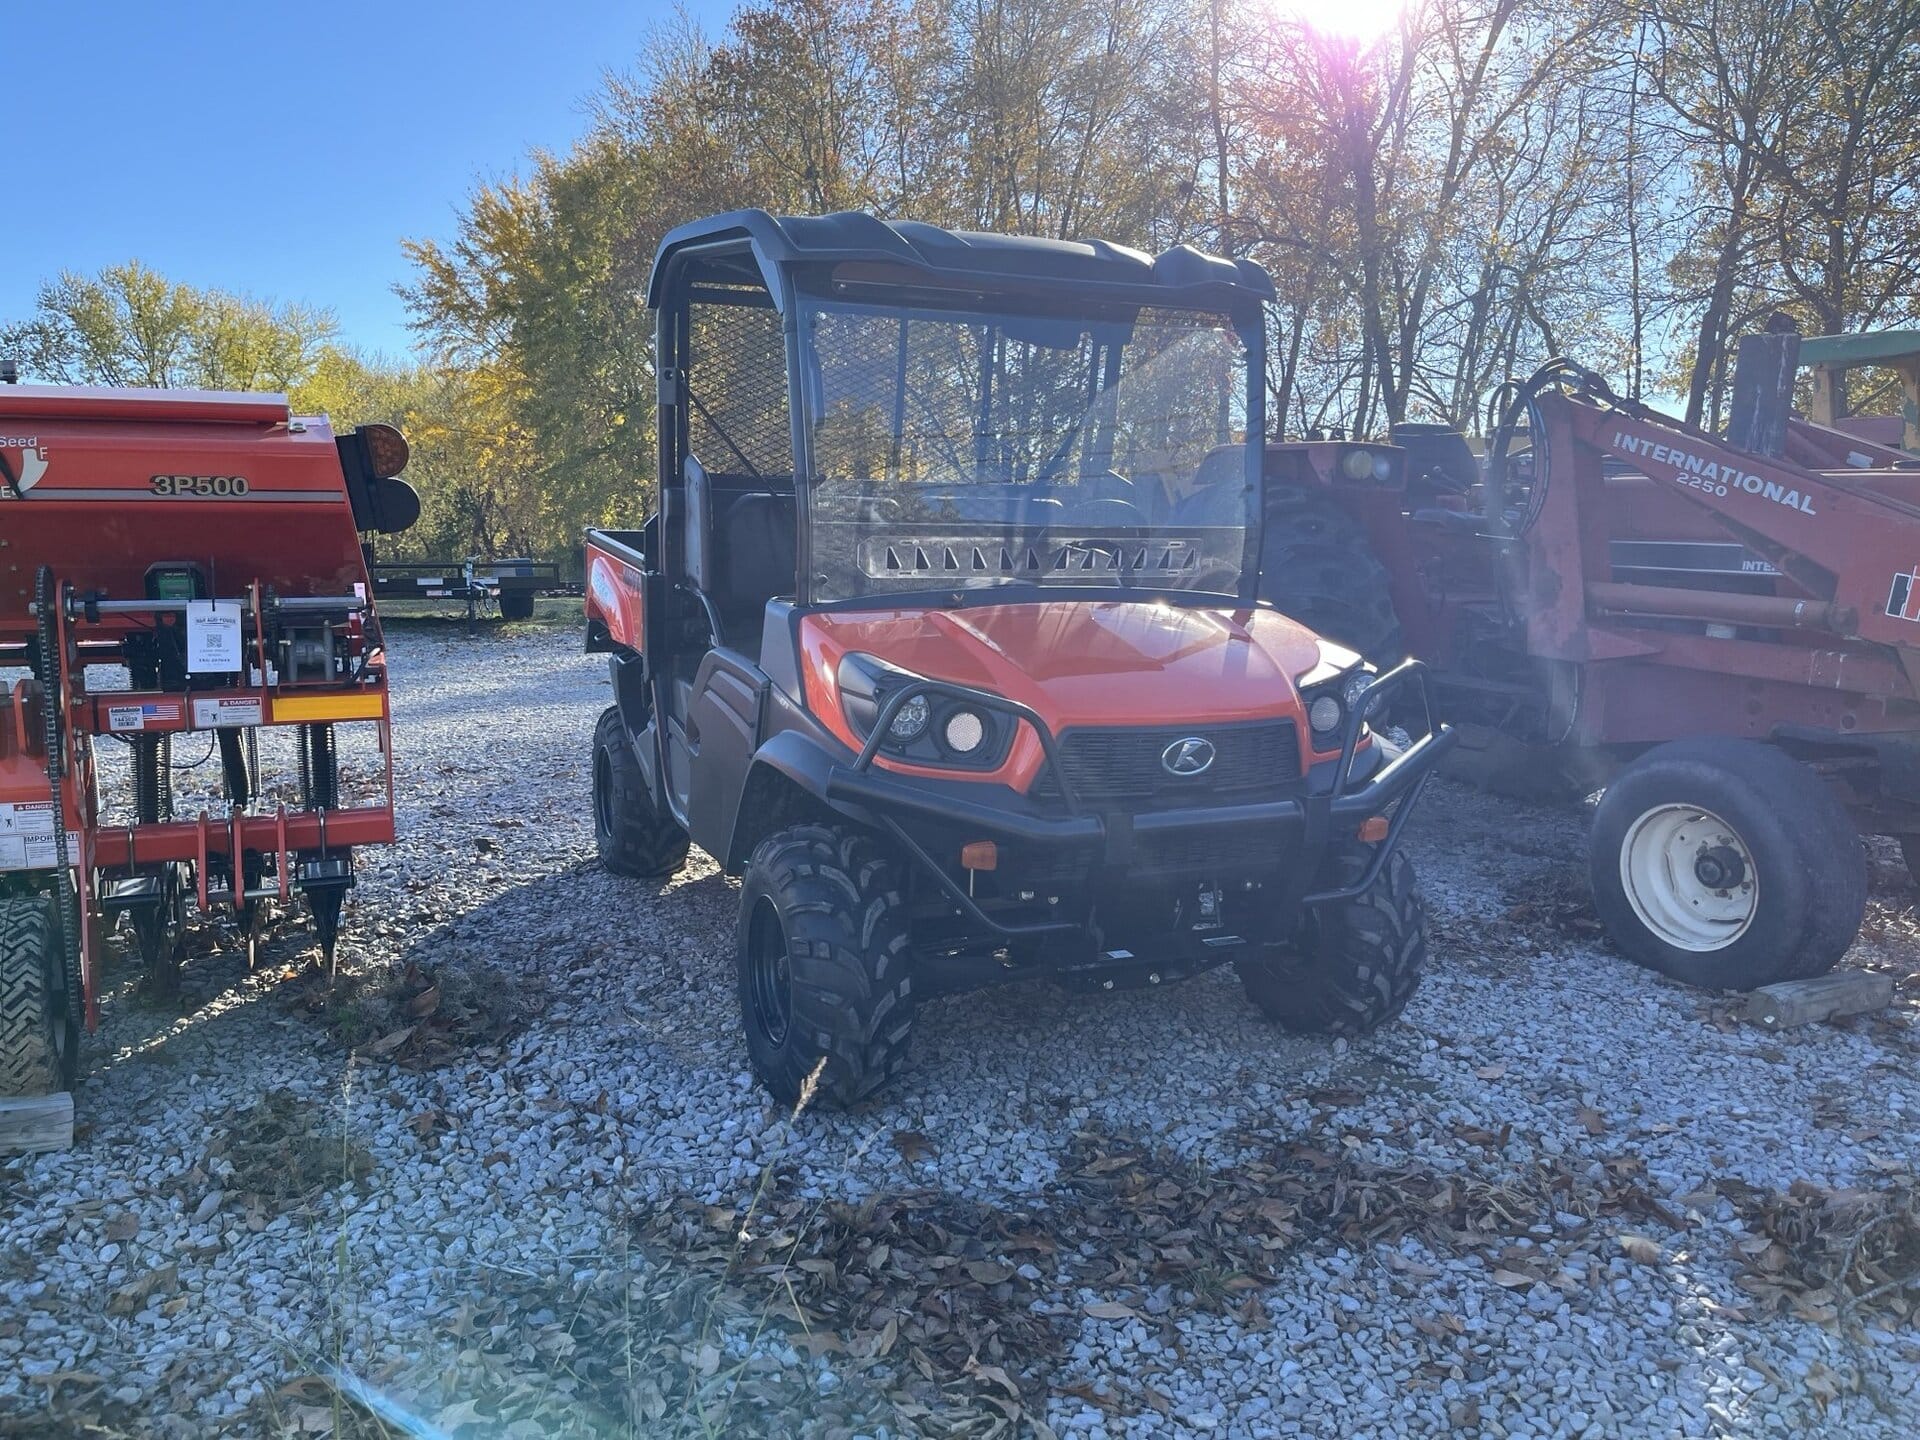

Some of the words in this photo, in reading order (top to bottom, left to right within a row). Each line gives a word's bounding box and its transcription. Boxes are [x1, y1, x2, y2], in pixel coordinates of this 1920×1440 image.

[0, 436, 37, 447] Seed
[40, 446, 48, 460] F
[1613, 431, 1817, 515] INTERNATIONAL
[1, 485, 11, 498] E
[151, 475, 250, 496] 3P500
[1676, 472, 1728, 497] 2250
[25, 832, 79, 843] IMPORNT!
